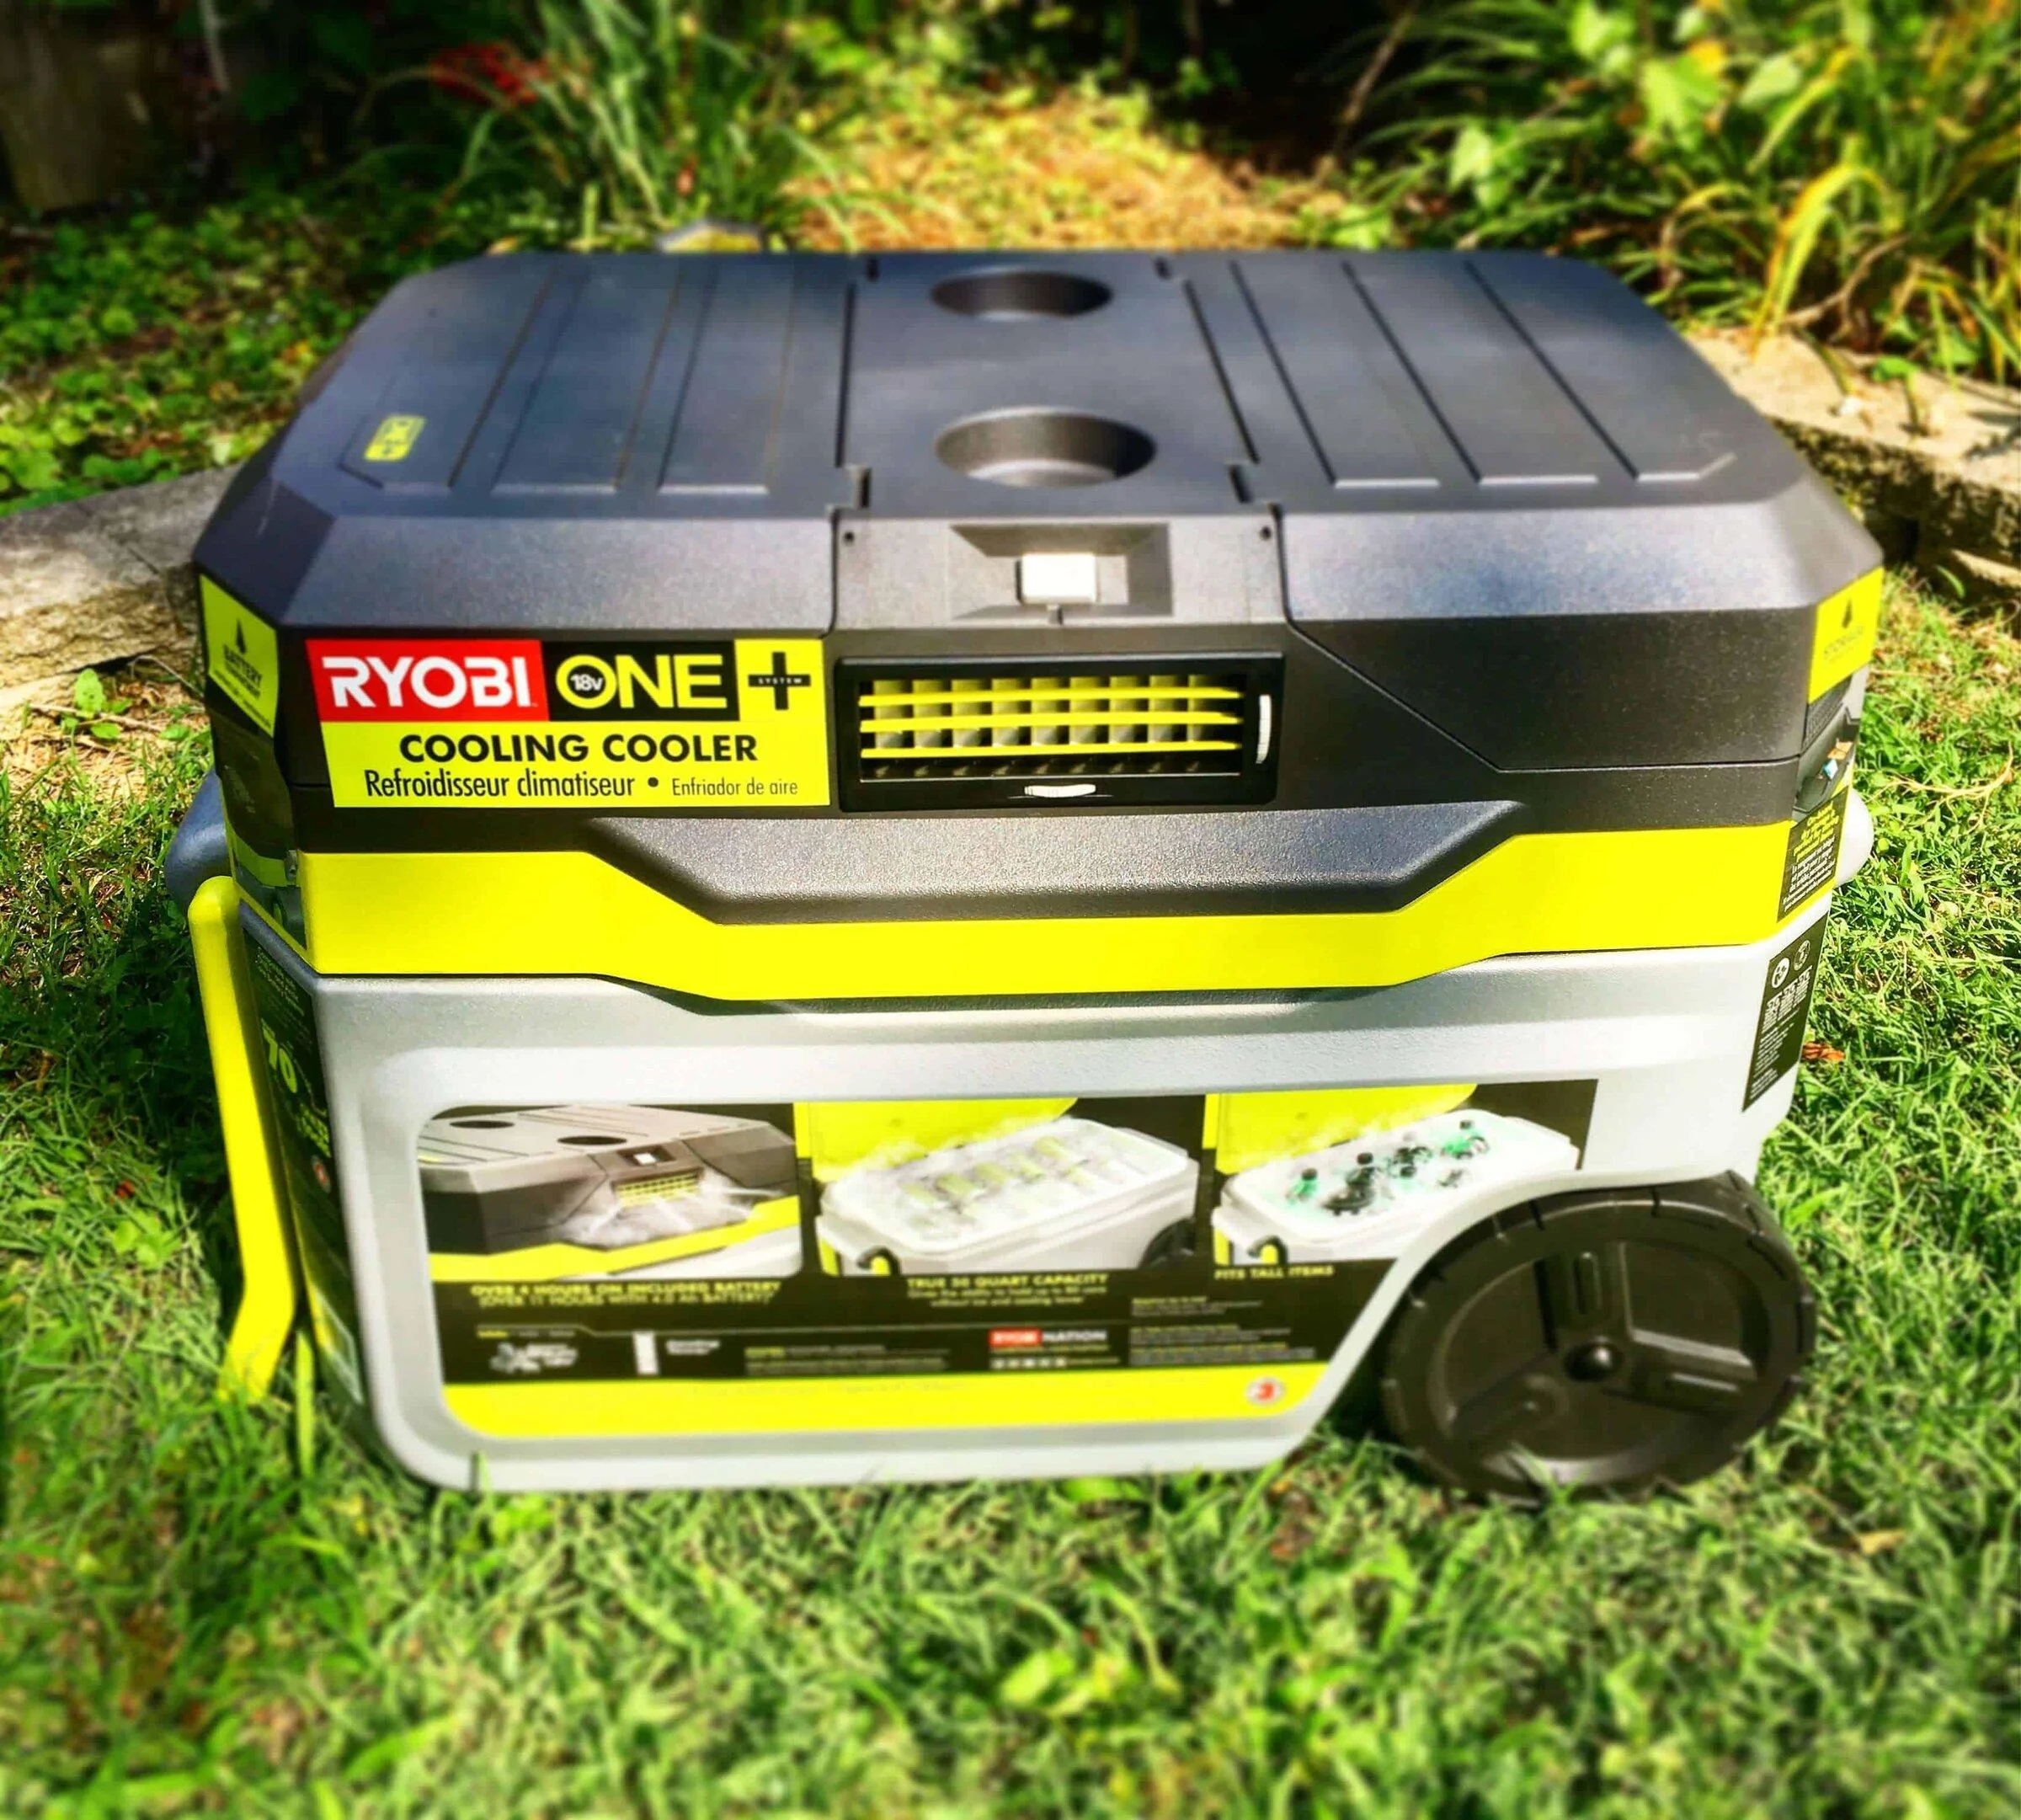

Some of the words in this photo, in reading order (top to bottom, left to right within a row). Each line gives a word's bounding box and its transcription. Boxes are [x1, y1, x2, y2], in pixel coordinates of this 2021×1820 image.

[322, 656, 532, 708] RYOBI
[556, 654, 728, 709] ONE
[399, 734, 589, 763] COOLING
[602, 734, 759, 763] COOLER
[364, 767, 509, 797] Refroidisseur
[517, 767, 635, 797] climatiseur
[672, 777, 741, 797] Enfriador
[746, 777, 765, 796] de
[770, 778, 798, 796] aire
[714, 1281, 781, 1293] BATTERY
[907, 1277, 946, 1289] TRUE
[1032, 1273, 1109, 1286] CAPACITY
